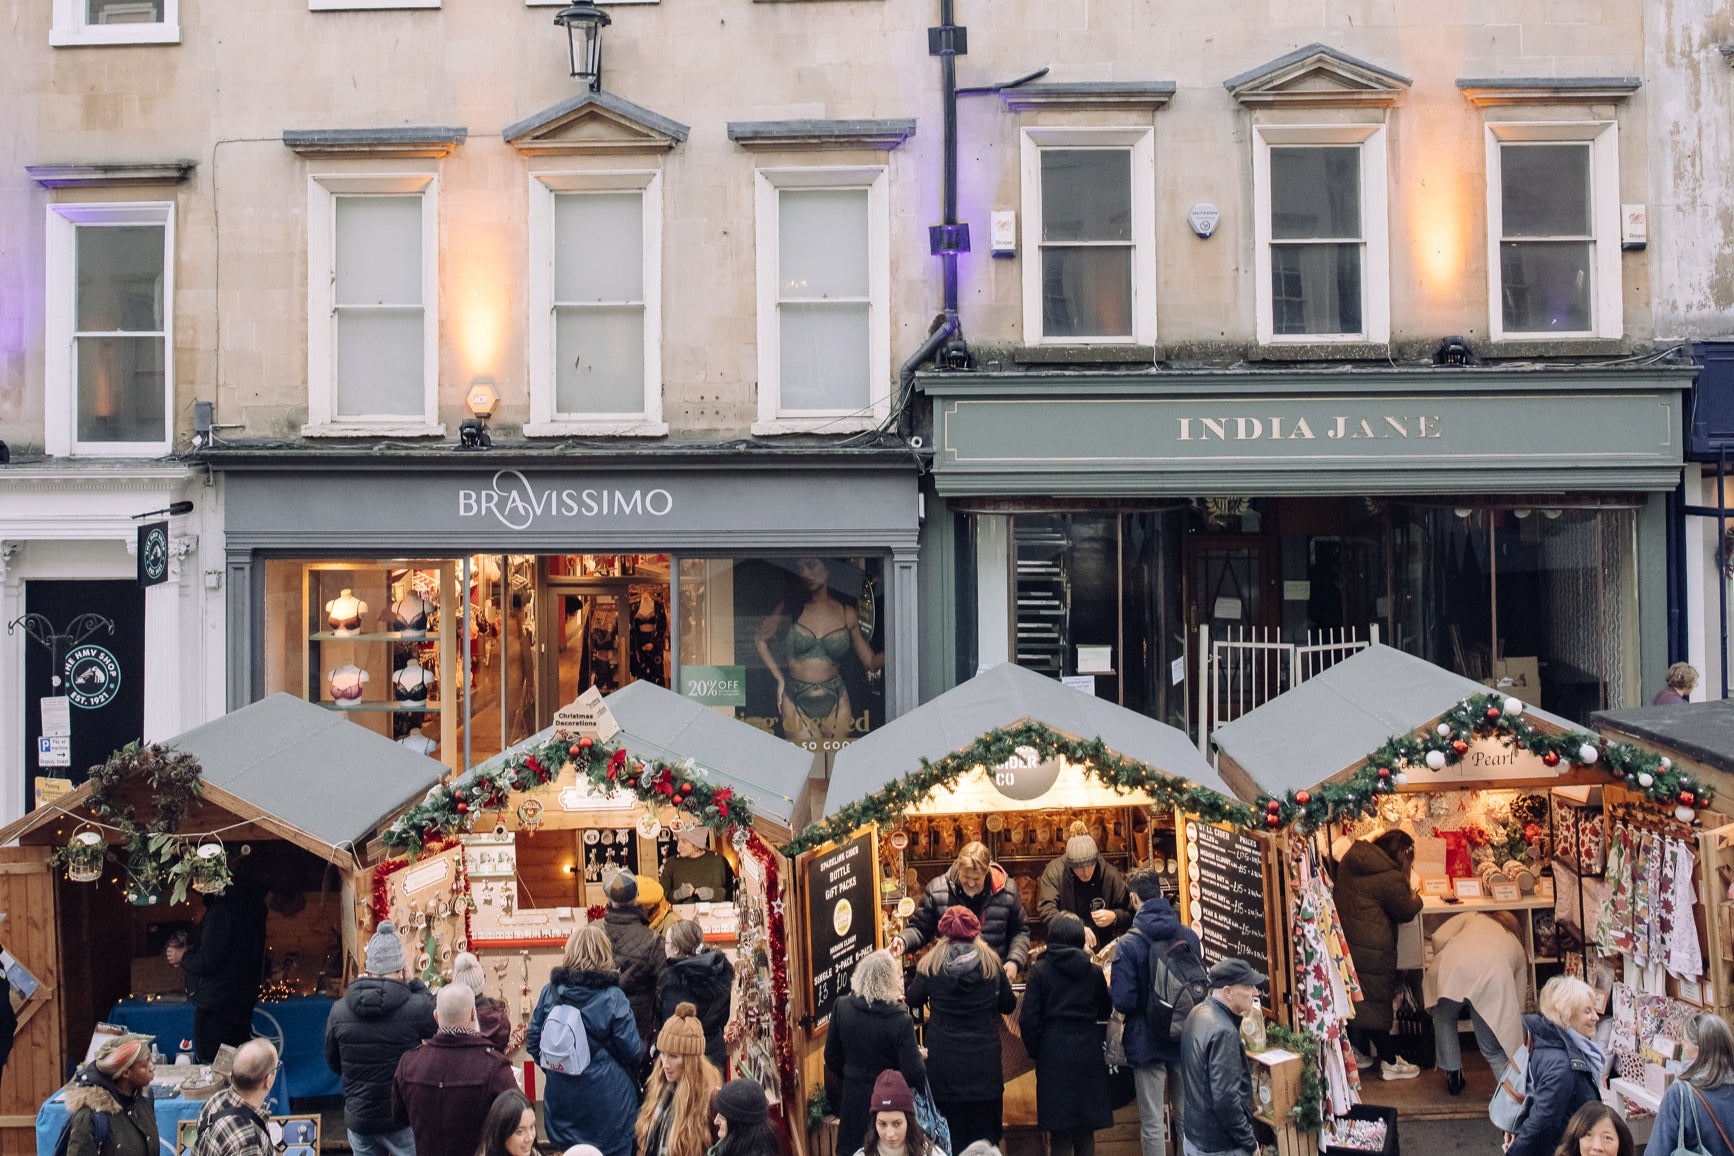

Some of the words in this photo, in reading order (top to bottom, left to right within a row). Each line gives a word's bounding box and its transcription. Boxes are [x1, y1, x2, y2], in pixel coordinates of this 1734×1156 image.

[1176, 416, 1316, 441] INDIA
[1328, 415, 1442, 440] JANE
[459, 469, 673, 530] BRAVISSIMO
[75, 649, 98, 660] HMV
[98, 652, 117, 677] SHOP
[688, 680, 718, 697] 20%
[718, 680, 739, 690] OFF
[70, 691, 88, 705] EST.
[90, 691, 109, 705] 1921
[558, 712, 594, 720] Christmas
[801, 741, 817, 751] SO
[823, 741, 857, 751] GOO
[1471, 751, 1514, 767] Pearl
[995, 772, 1015, 787] CO
[845, 845, 859, 859] CIDER
[829, 863, 851, 883] BOTTLE
[825, 884, 838, 900] GIFT
[839, 875, 857, 894] PACKS
[814, 967, 833, 986] SINGLE
